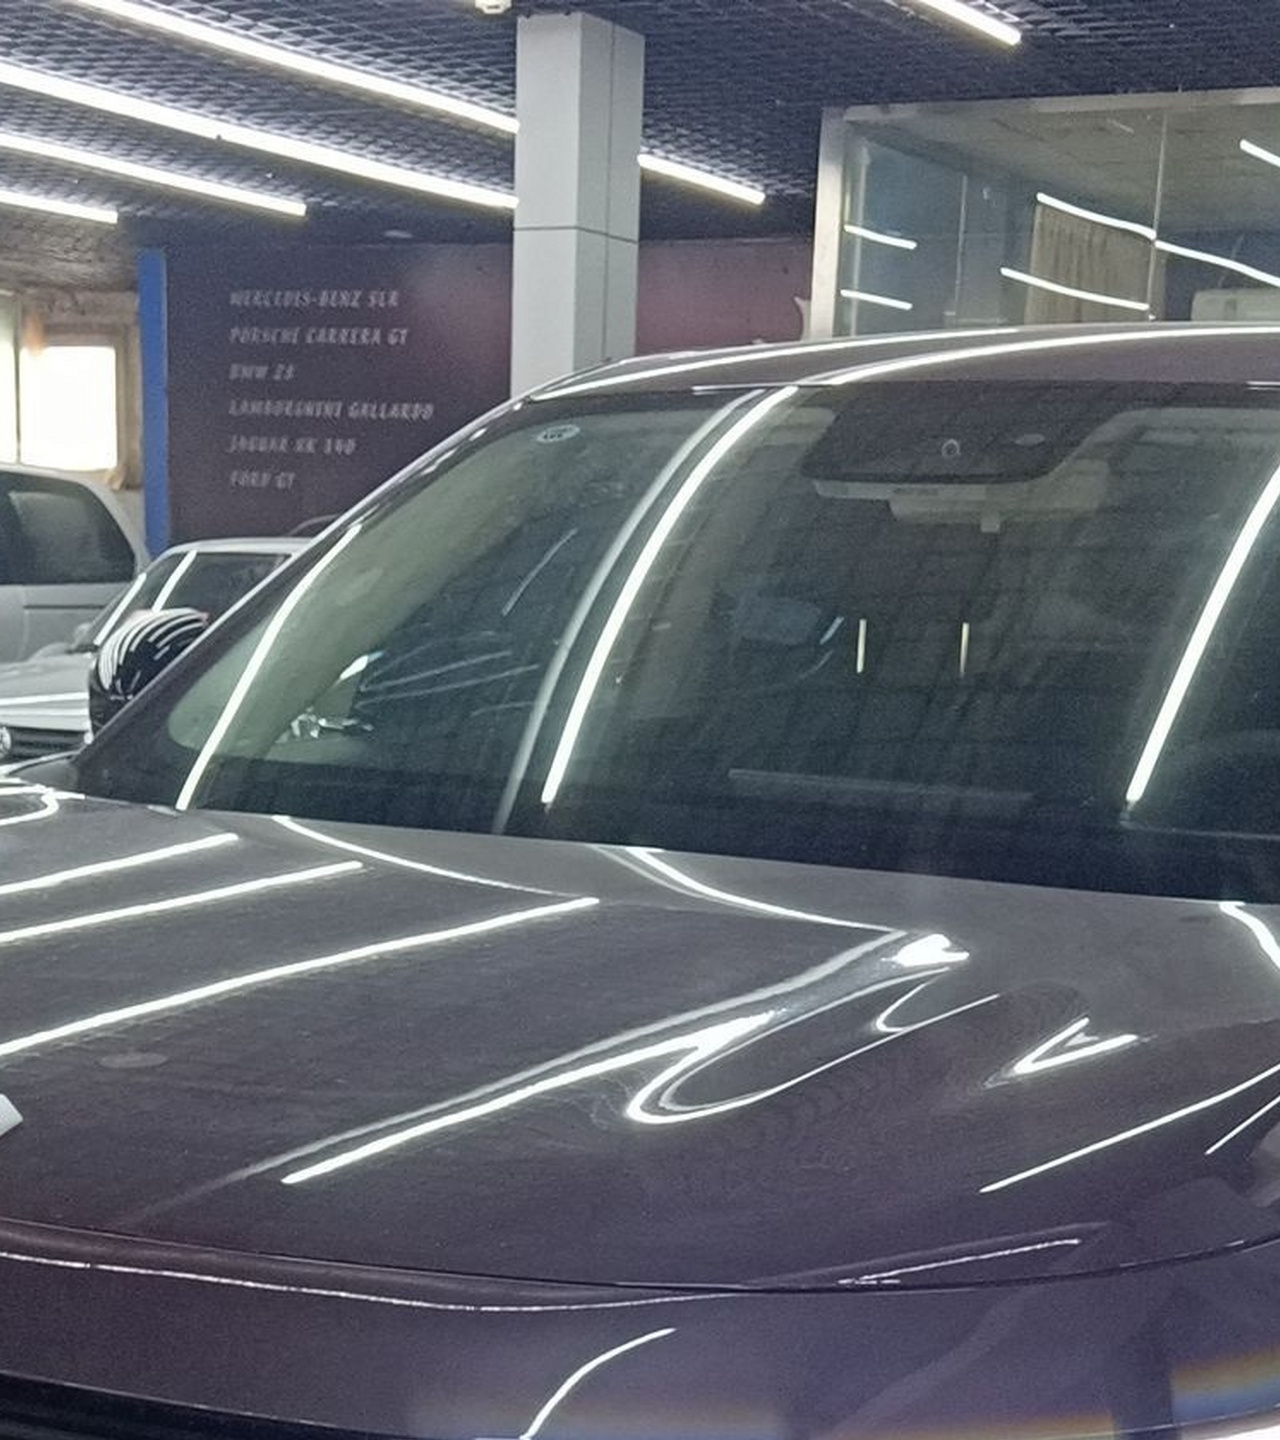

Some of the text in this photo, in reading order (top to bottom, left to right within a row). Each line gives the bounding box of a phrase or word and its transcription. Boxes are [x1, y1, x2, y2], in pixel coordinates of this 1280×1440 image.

[229, 325, 409, 346] PORSCHE CARRERA GT
